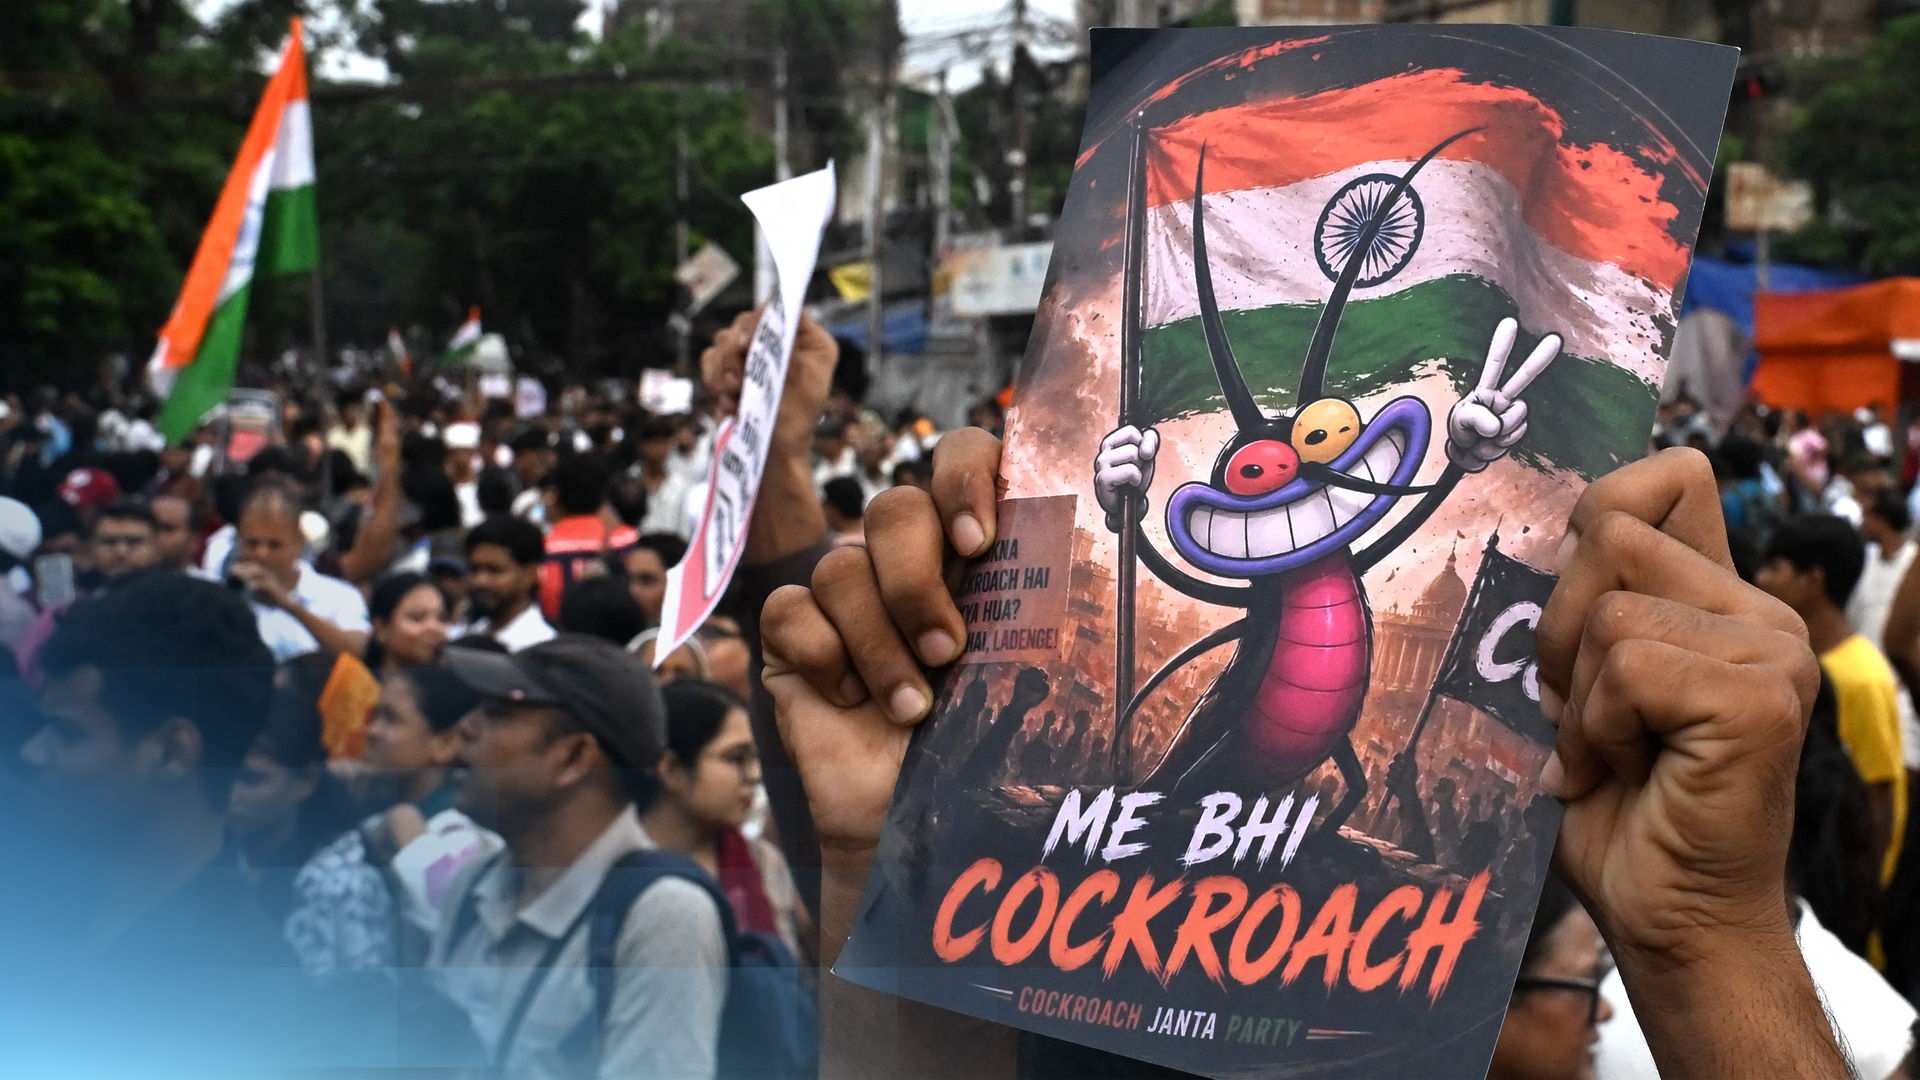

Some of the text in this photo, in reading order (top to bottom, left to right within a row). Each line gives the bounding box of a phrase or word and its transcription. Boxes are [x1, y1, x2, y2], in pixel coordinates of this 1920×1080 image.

[1023, 567, 1050, 589] HAI
[983, 599, 1022, 622] HUA?
[993, 628, 1059, 651] LADENGE!
[1041, 786, 1320, 873] ME BHI
[932, 857, 1491, 1010] COCKROACH
[1018, 986, 1303, 1048] COCKROACH JANTA PARTY
